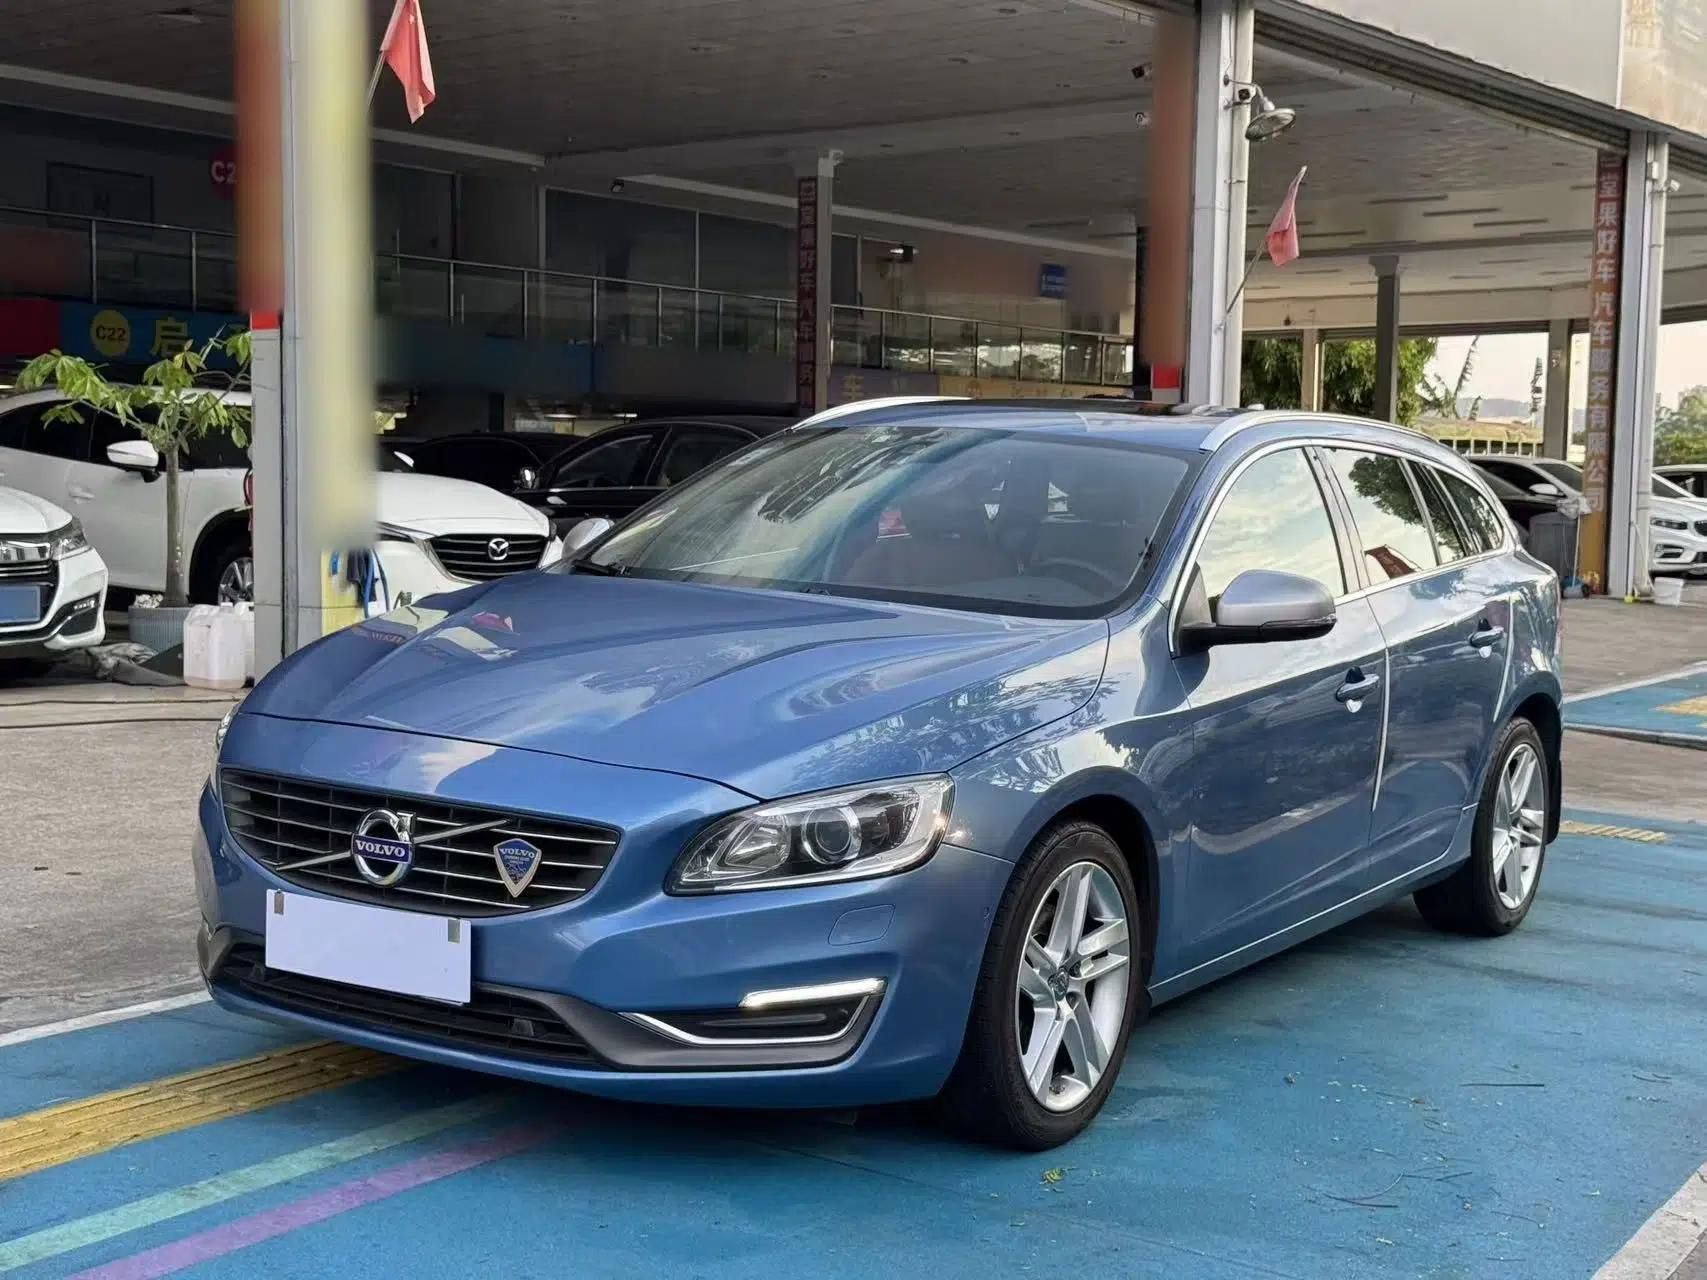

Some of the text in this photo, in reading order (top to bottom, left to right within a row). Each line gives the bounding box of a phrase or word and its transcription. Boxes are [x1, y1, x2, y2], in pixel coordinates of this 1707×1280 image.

[96, 325, 126, 342] C22
[355, 840, 405, 858] VOLVO
[499, 848, 535, 859] VOLVO
